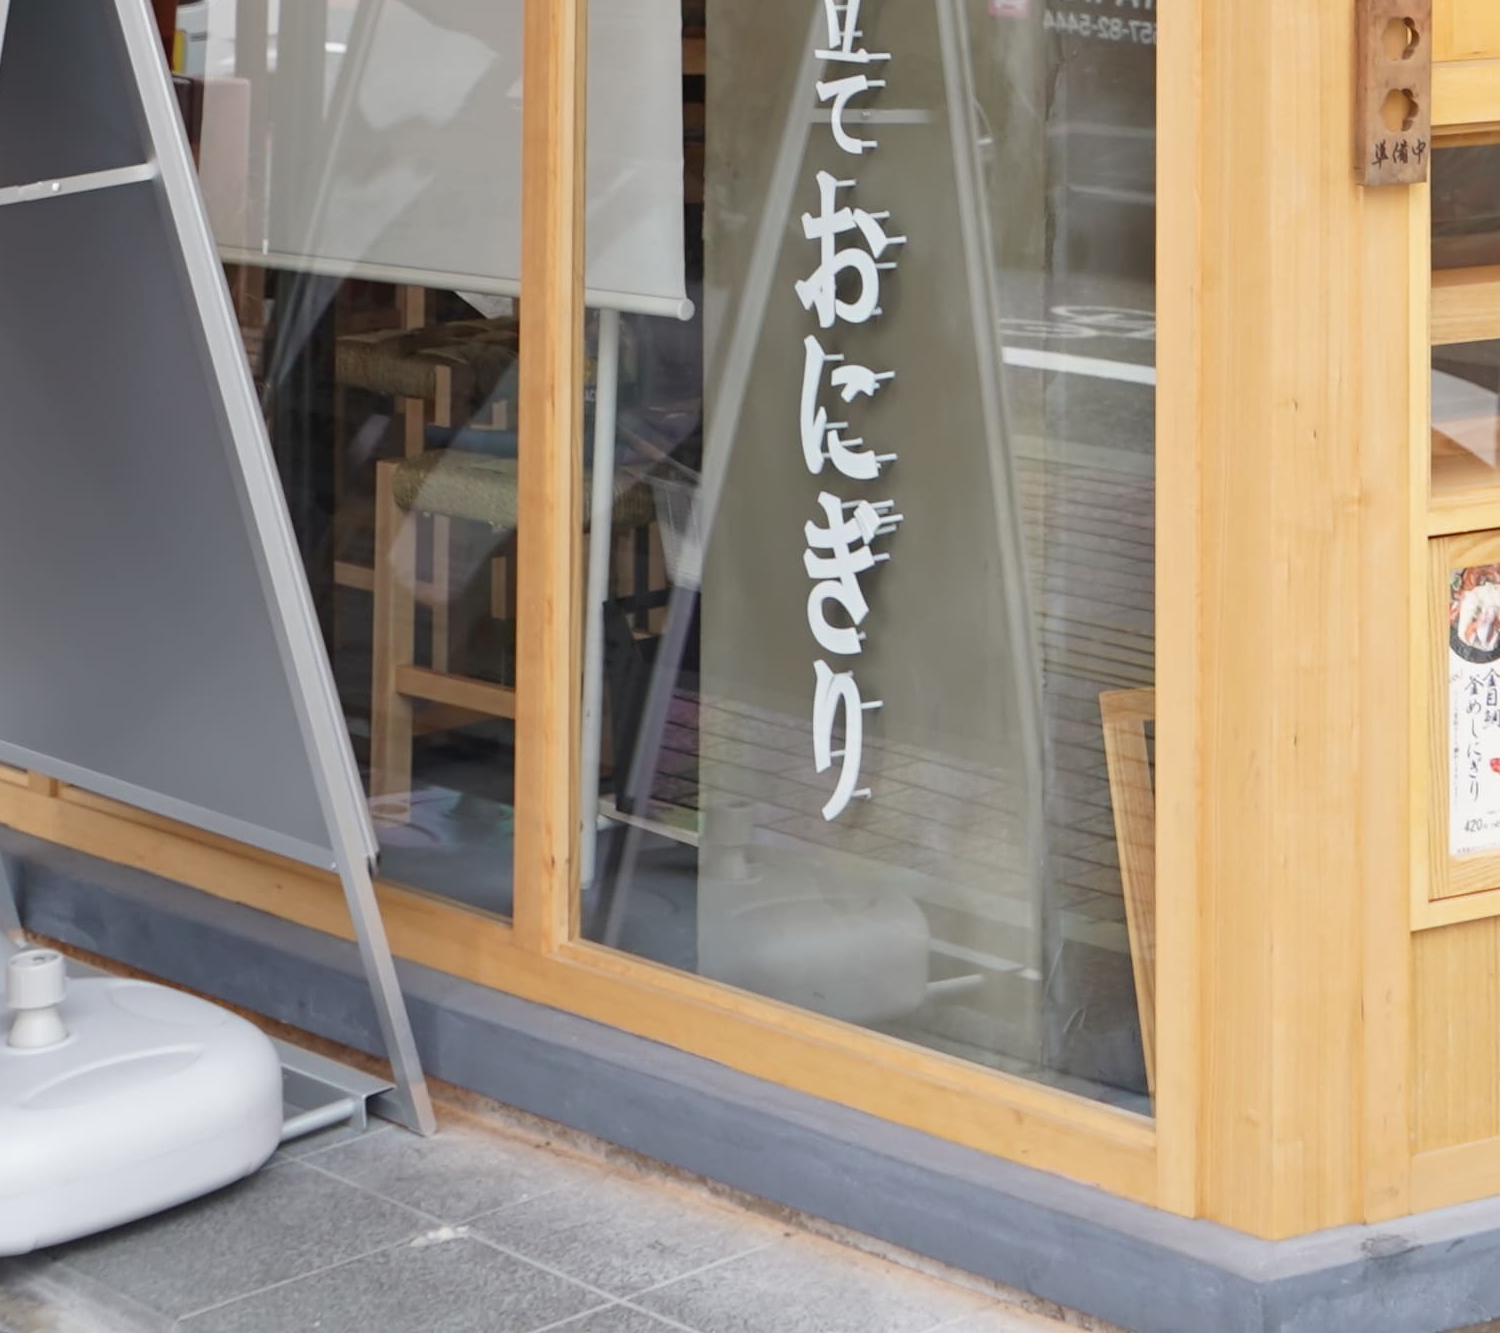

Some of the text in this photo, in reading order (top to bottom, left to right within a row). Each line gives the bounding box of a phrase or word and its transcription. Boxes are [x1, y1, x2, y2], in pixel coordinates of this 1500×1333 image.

[1464, 673, 1484, 803] 釜めしにぎり
